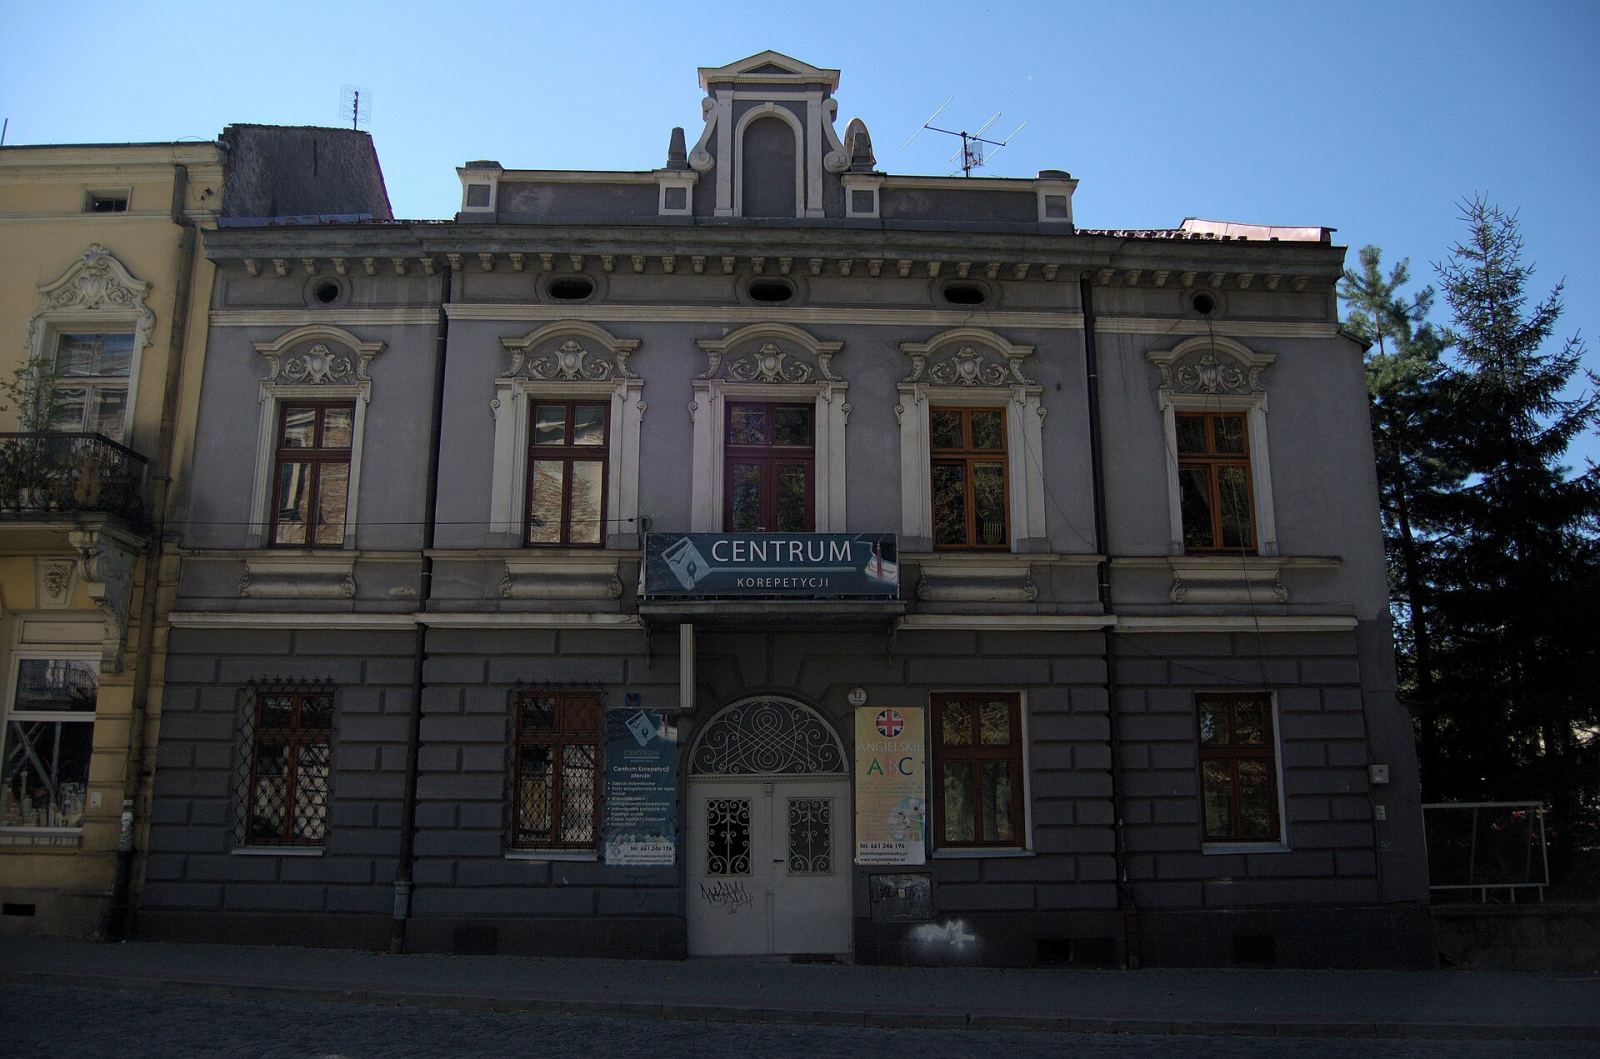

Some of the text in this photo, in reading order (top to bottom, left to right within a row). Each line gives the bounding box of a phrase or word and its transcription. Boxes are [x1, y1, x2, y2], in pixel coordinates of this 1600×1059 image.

[711, 540, 852, 562] CENTRUM
[737, 577, 829, 588] KOREPETYCJI
[857, 742, 922, 752] ANGIELSKIE
